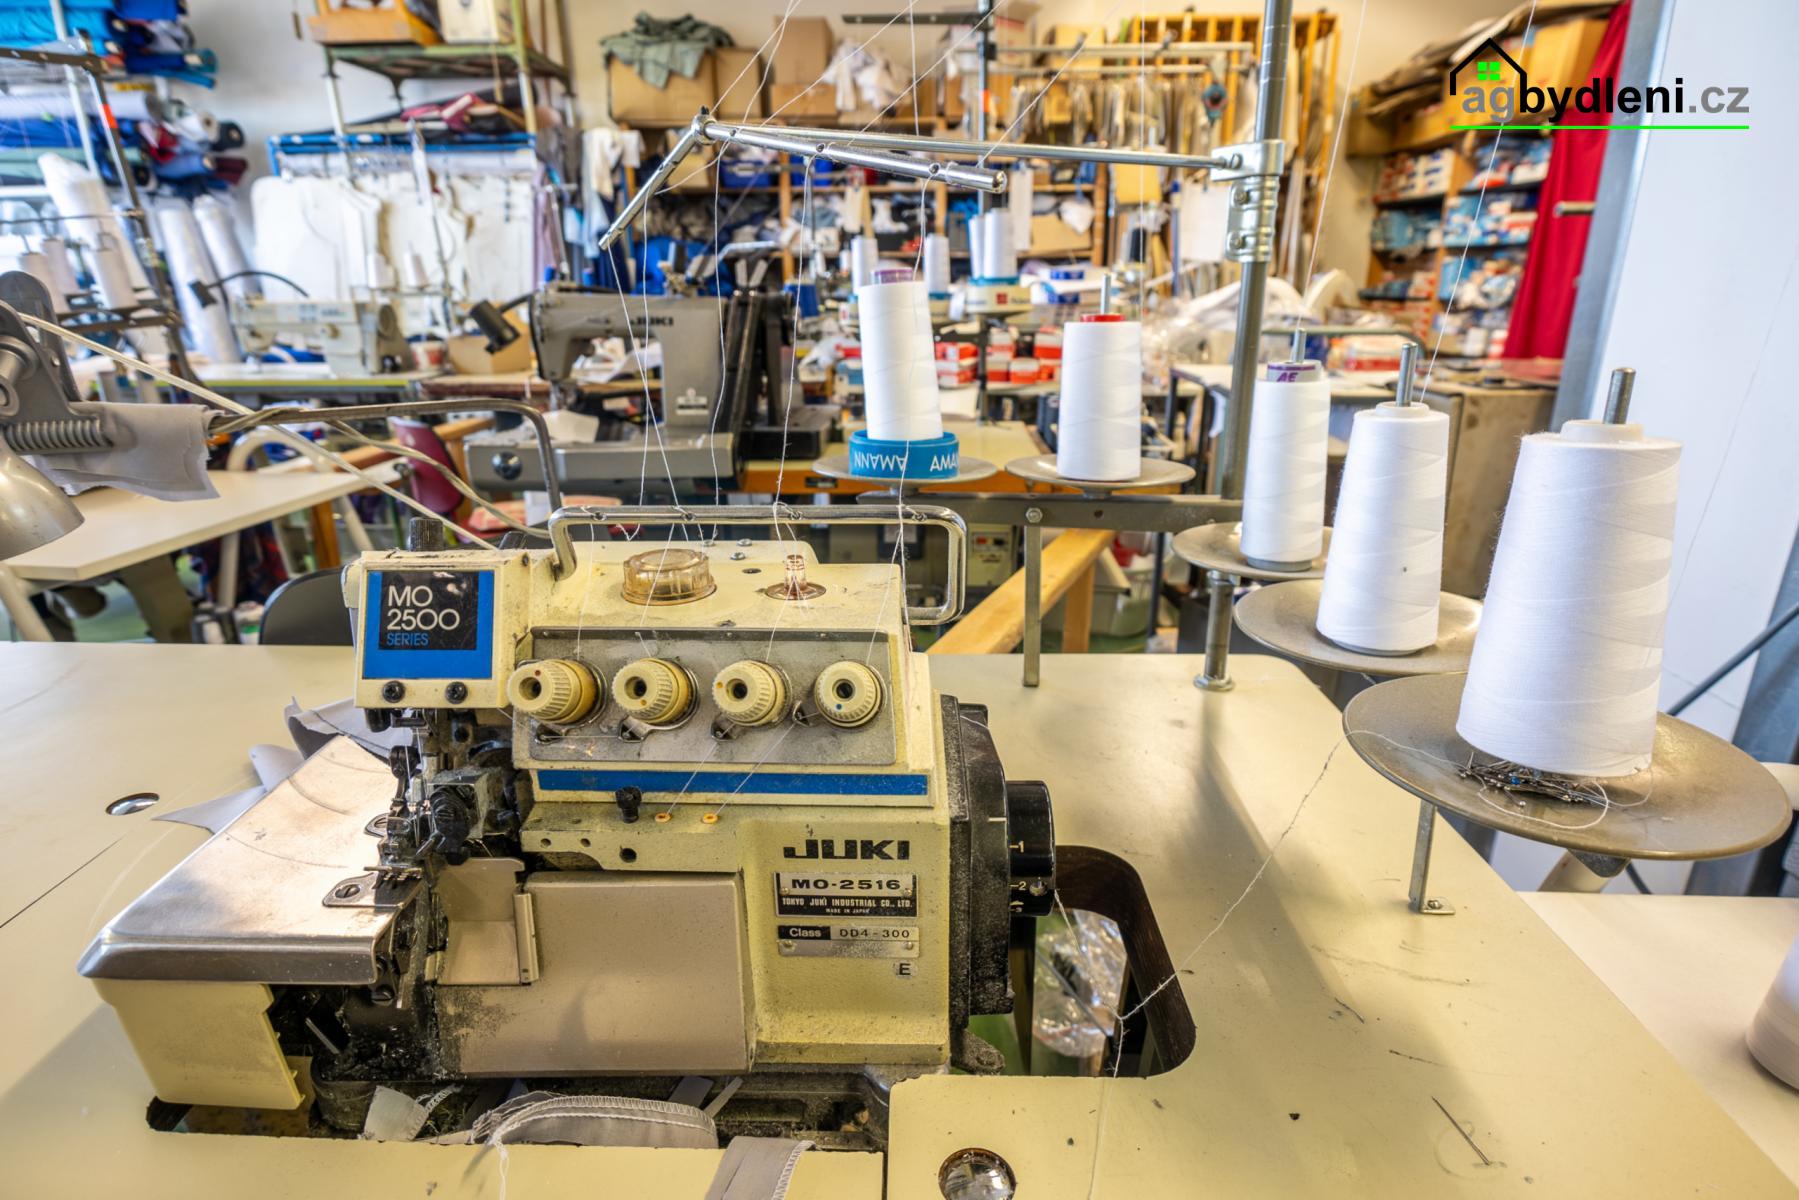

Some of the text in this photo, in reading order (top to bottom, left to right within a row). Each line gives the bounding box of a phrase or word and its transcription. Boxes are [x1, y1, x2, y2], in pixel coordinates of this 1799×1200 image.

[388, 585, 433, 607] MO
[387, 608, 460, 630] 2500
[386, 632, 429, 646] SERIES
[783, 839, 910, 860] JUKI
[791, 878, 901, 890] MO-2516
[782, 897, 804, 906] TOKYO
[809, 897, 828, 907] JUKI
[831, 897, 877, 908] INDUSTRIAL
[789, 927, 822, 938] Class
[899, 963, 911, 976] E
